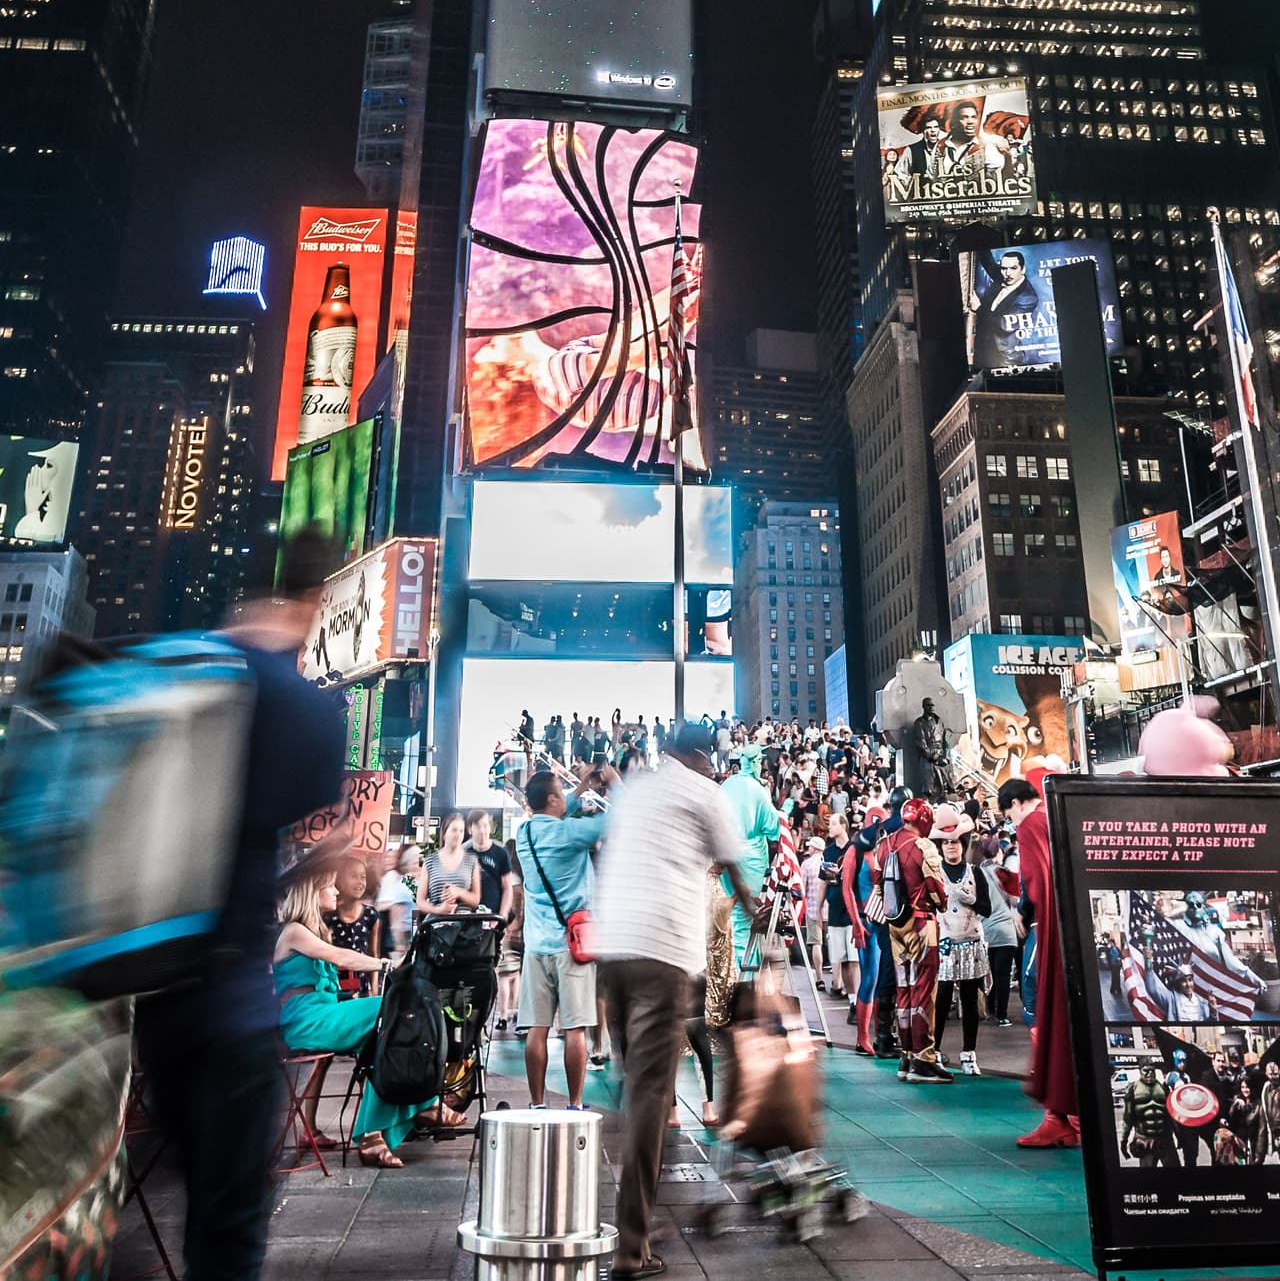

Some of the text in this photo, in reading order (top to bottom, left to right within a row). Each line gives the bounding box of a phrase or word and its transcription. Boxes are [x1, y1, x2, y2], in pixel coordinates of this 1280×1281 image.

[880, 97, 908, 108] FINAL
[936, 157, 974, 178] Les
[888, 167, 1032, 202] Misérables
[312, 220, 371, 236] Budweiser
[299, 242, 318, 252] THIS
[319, 243, 345, 253] BUD'S
[345, 244, 363, 254] FOR
[1039, 258, 1062, 269] LET
[1015, 329, 1033, 340] OF
[175, 416, 209, 529] NOVOTEL
[395, 544, 426, 657] HELLO!
[328, 599, 371, 638] MORMON
[998, 645, 1080, 666] ICE AGE
[991, 665, 1046, 676] COLLISION
[1082, 821, 1267, 834] IF YOU TAKE A PHOTO WITH AN
[1084, 835, 1256, 848] ENTERTAINER, PLEASE NOTE
[1086, 850, 1204, 861] THEY EXPECT A TIP
